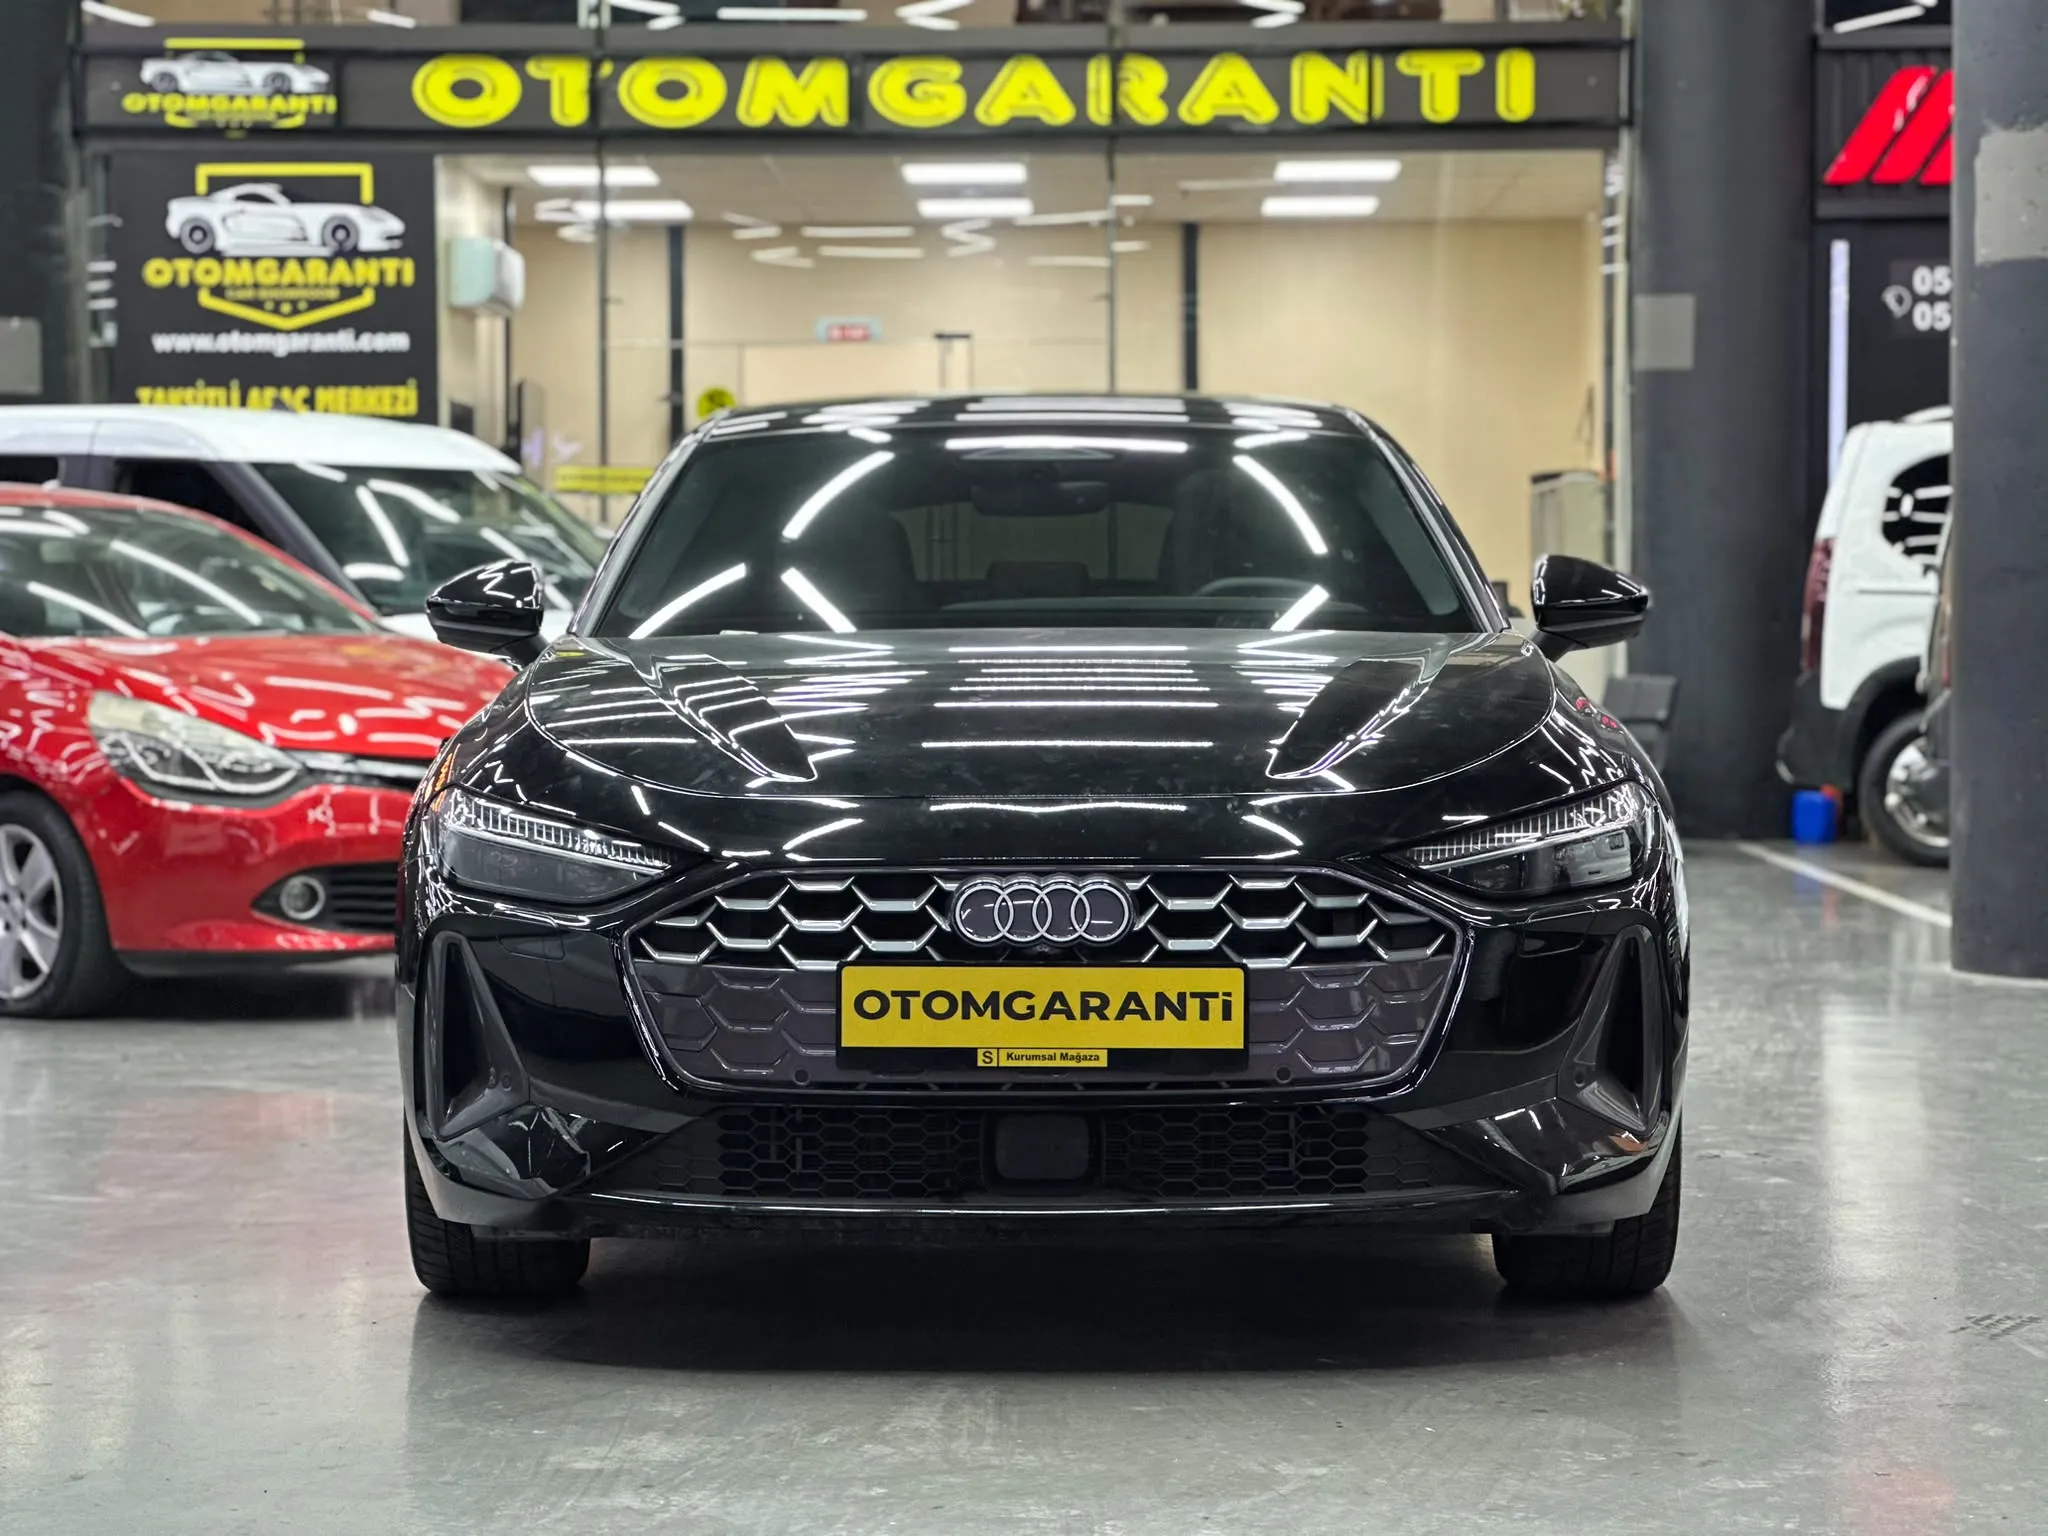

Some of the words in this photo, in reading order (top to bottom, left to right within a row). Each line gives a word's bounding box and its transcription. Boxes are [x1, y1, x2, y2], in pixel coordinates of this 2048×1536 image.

[121, 92, 338, 114] OTOMGARANTI
[411, 50, 1536, 128] OTOMGARANTI
[143, 257, 416, 288] OTOMGARANTI
[152, 328, 411, 358] www.otomgaranti.com
[981, 1050, 994, 1065] S
[1006, 1051, 1057, 1062] Kurumsal
[1059, 1051, 1100, 1064] Mağaza
